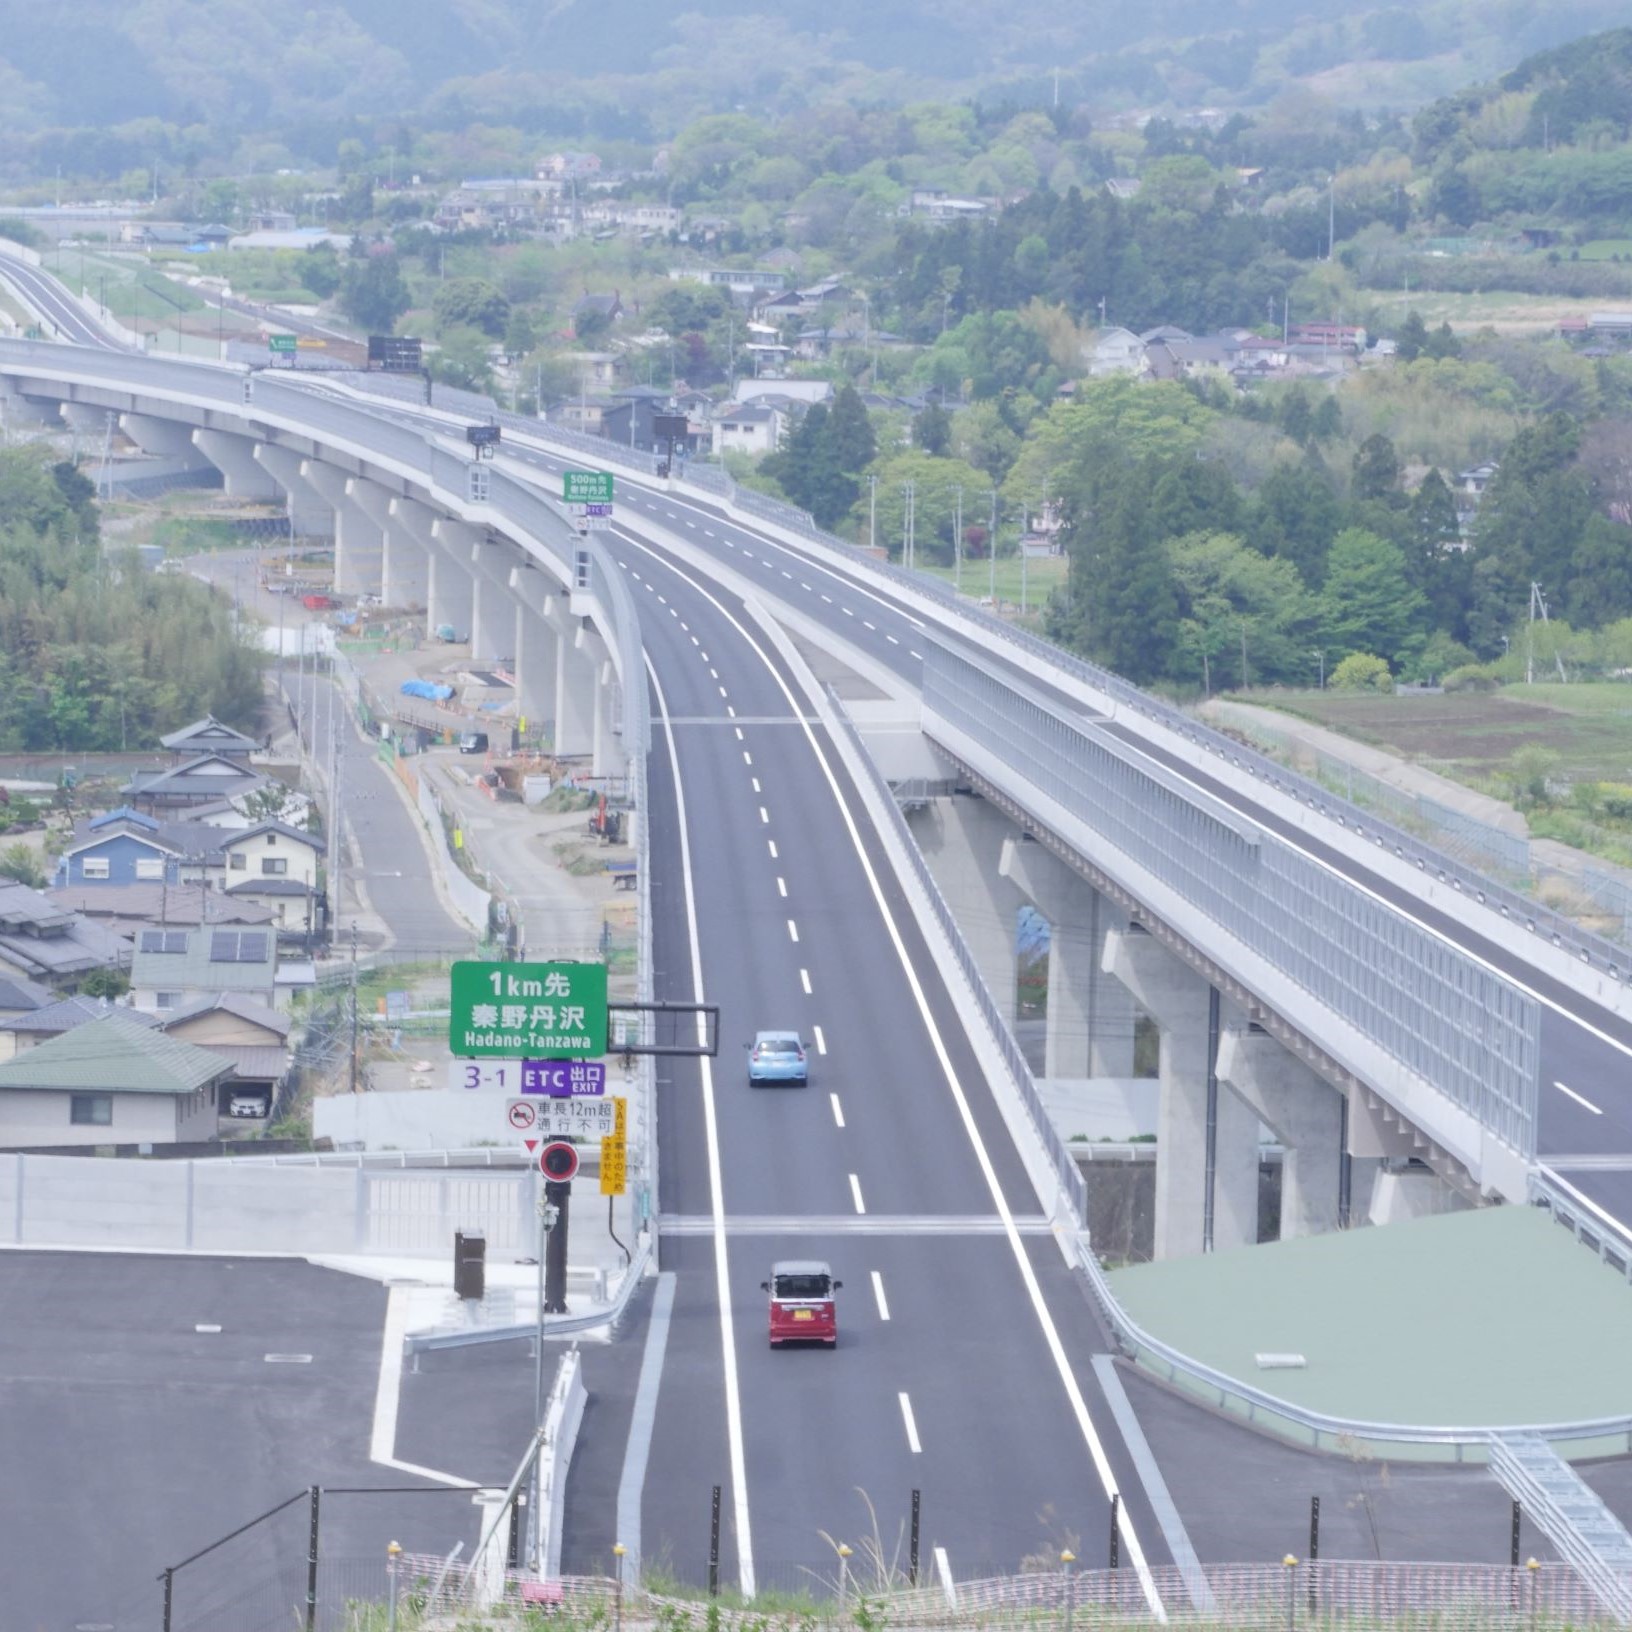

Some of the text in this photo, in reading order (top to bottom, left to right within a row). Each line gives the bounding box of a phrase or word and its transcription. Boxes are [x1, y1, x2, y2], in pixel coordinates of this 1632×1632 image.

[489, 971, 571, 997] 1km先
[471, 1004, 586, 1031] 秦野丹沢
[464, 1031, 592, 1050] Hadano-Tanzawa
[463, 1066, 506, 1089] 3-1
[525, 1069, 565, 1088] ETC
[570, 1065, 600, 1082] 出口
[572, 1082, 598, 1094] EXIT
[537, 1101, 612, 1117] 車長12m超
[537, 1118, 611, 1133] 通行不可
